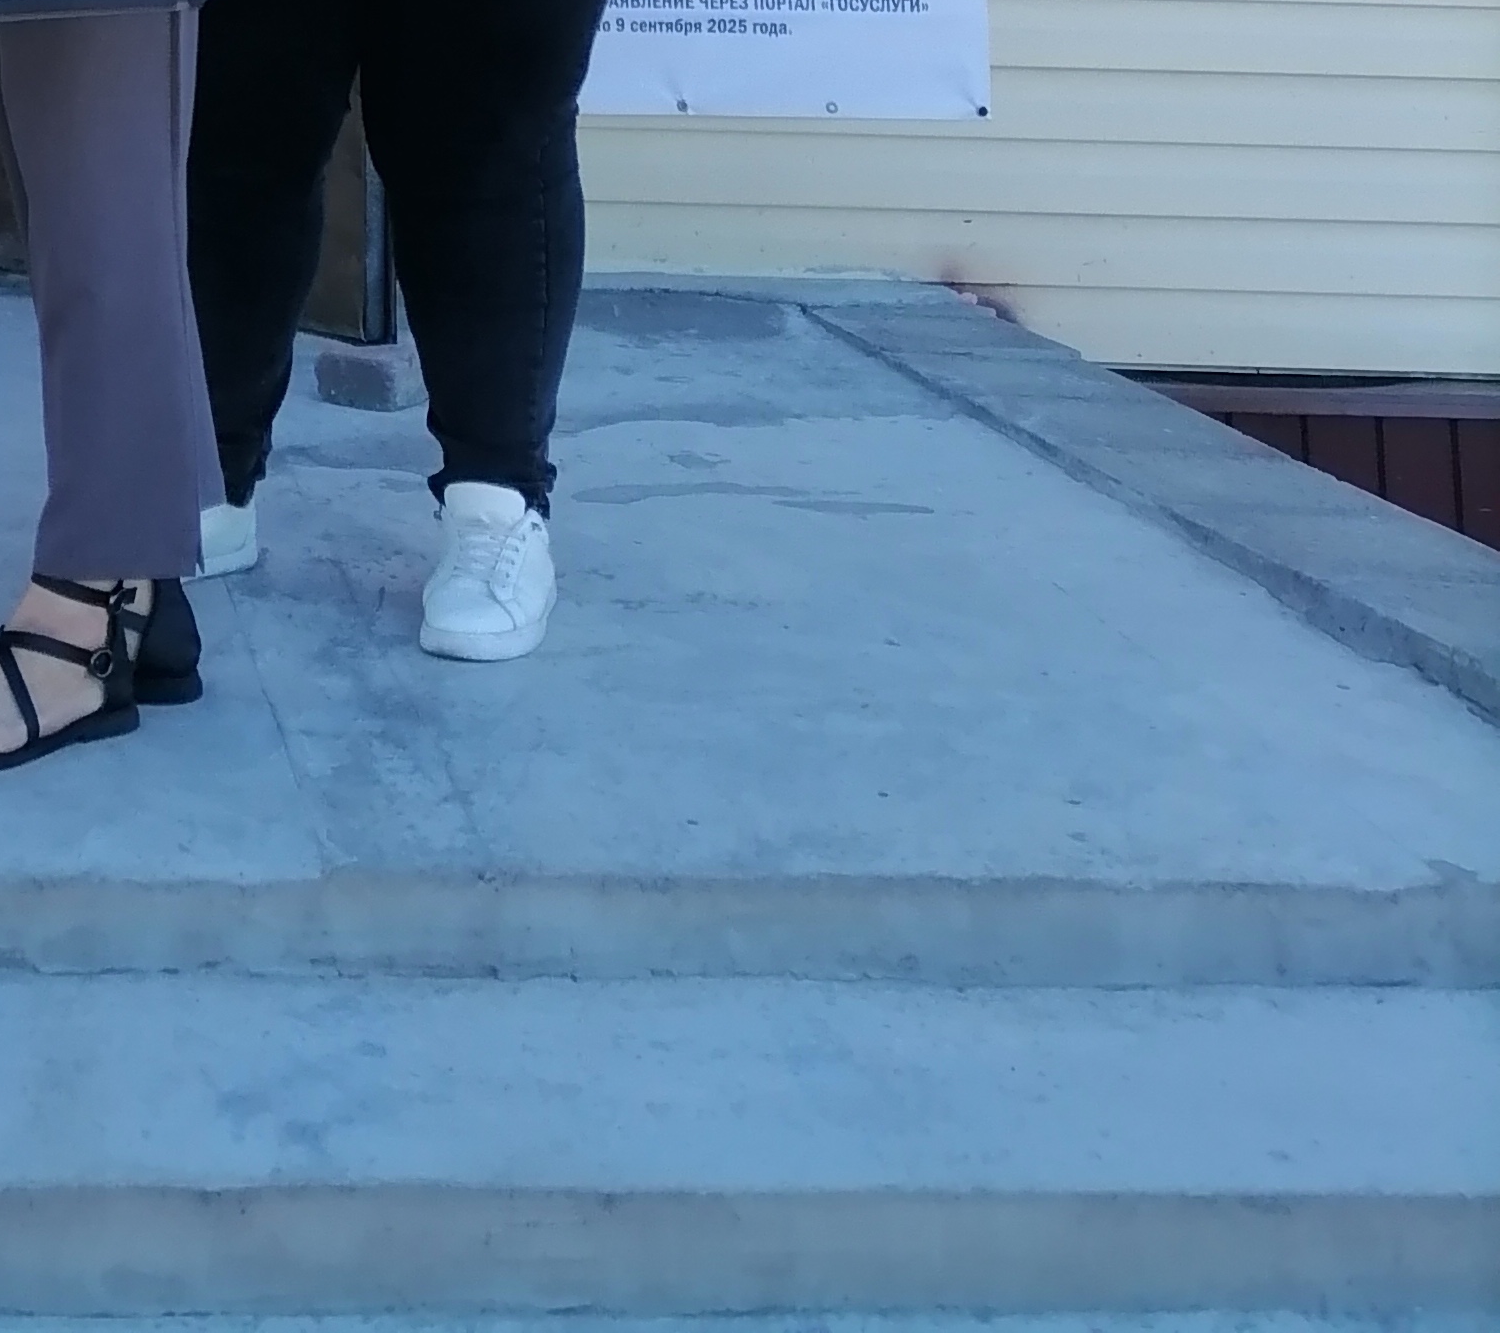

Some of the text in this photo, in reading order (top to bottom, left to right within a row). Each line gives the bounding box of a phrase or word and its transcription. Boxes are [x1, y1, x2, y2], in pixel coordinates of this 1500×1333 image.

[616, 18, 625, 32] 9
[630, 19, 702, 36] сентября
[708, 19, 747, 34] 2025
[752, 22, 792, 37] года.
